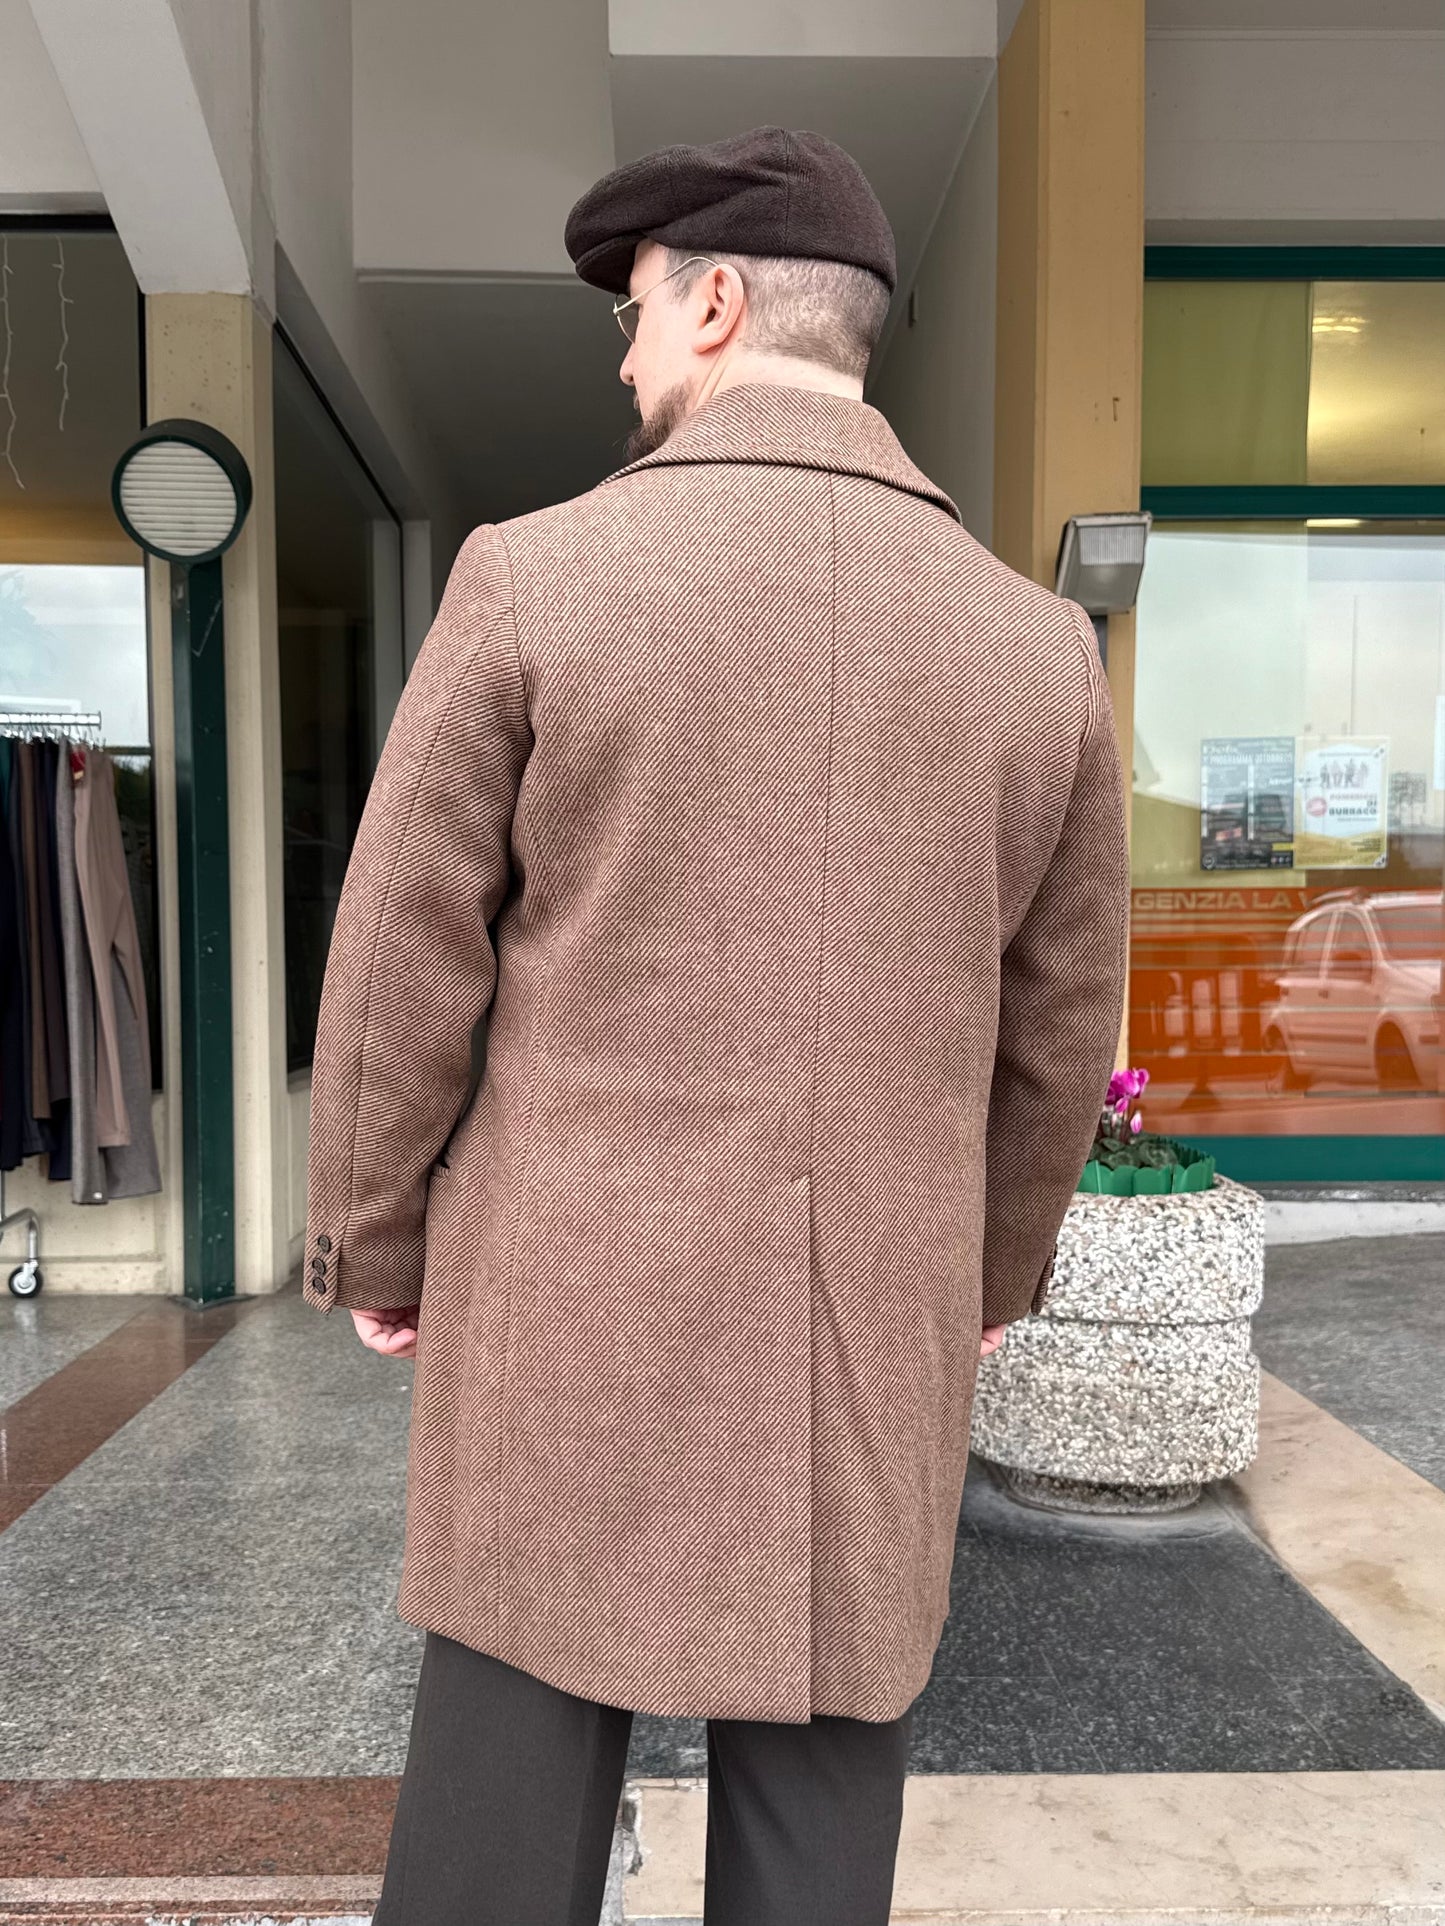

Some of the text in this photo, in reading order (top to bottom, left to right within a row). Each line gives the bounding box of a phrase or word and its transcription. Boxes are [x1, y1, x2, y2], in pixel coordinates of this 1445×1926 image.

[1329, 807, 1377, 816] BURRACO
[1134, 892, 1246, 910] GENZIA
[1252, 892, 1292, 910] LA
